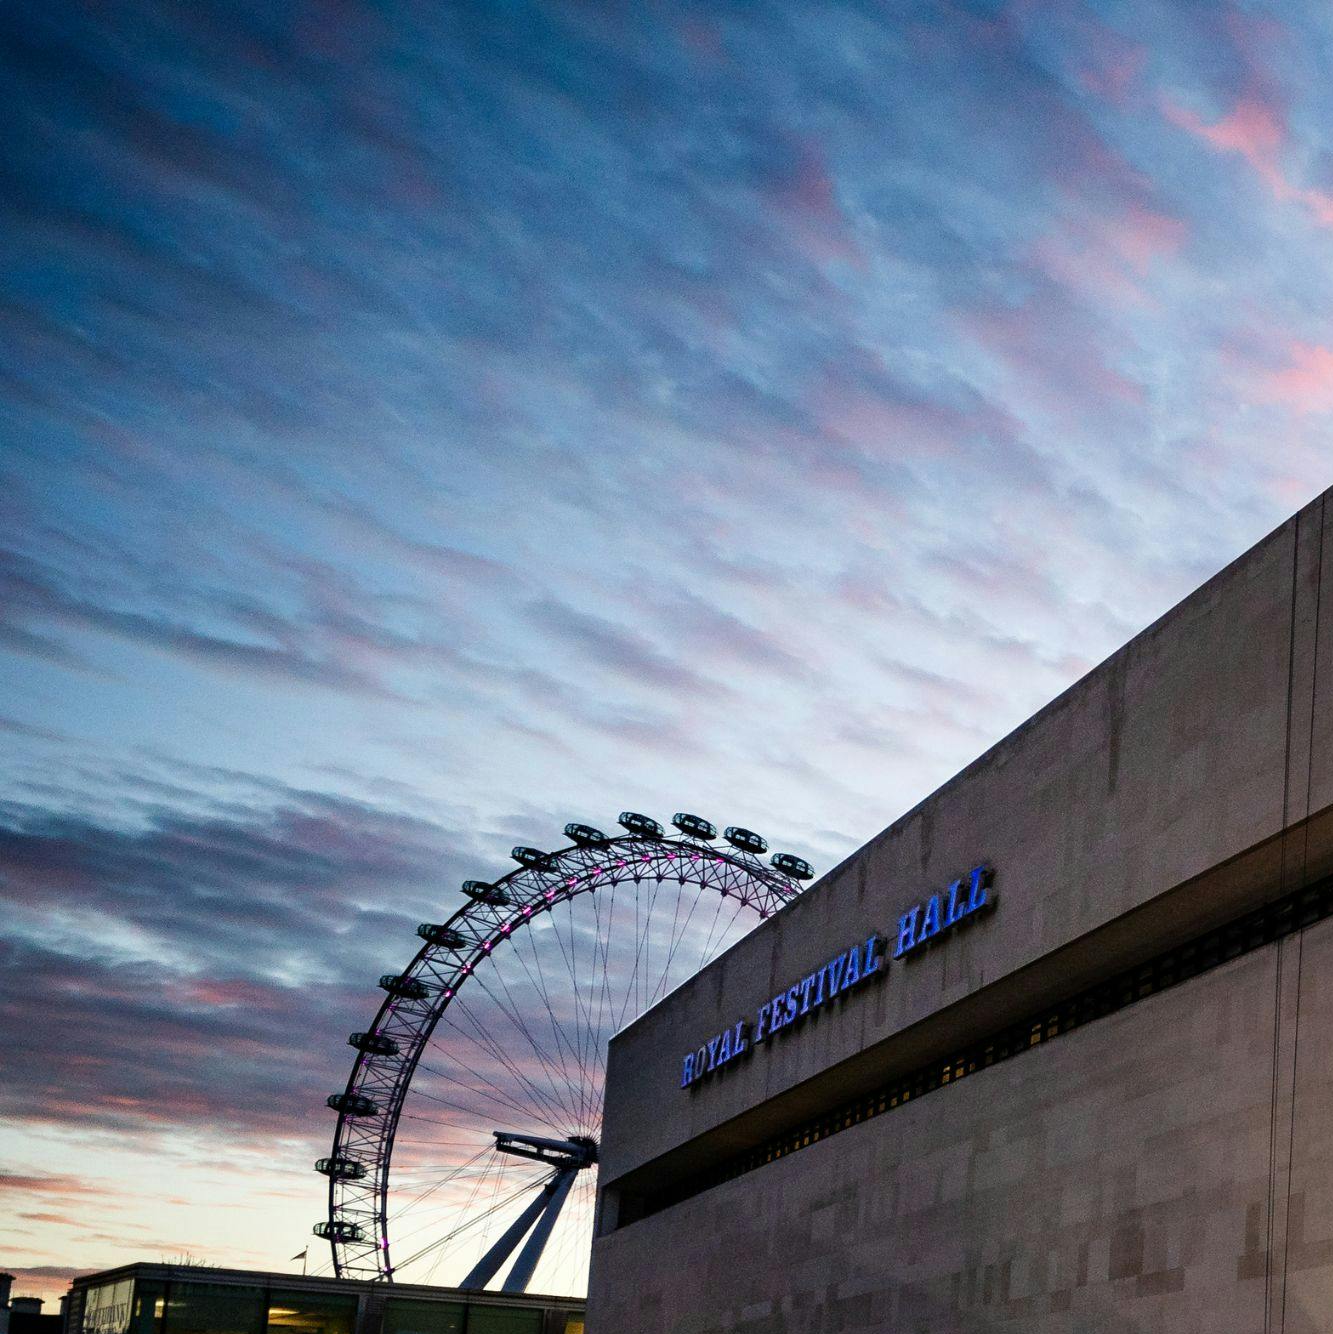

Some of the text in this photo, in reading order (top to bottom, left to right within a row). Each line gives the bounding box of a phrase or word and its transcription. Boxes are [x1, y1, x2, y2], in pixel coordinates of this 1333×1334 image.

[680, 865, 991, 1089] ROYAL FESTIVAL HALL
